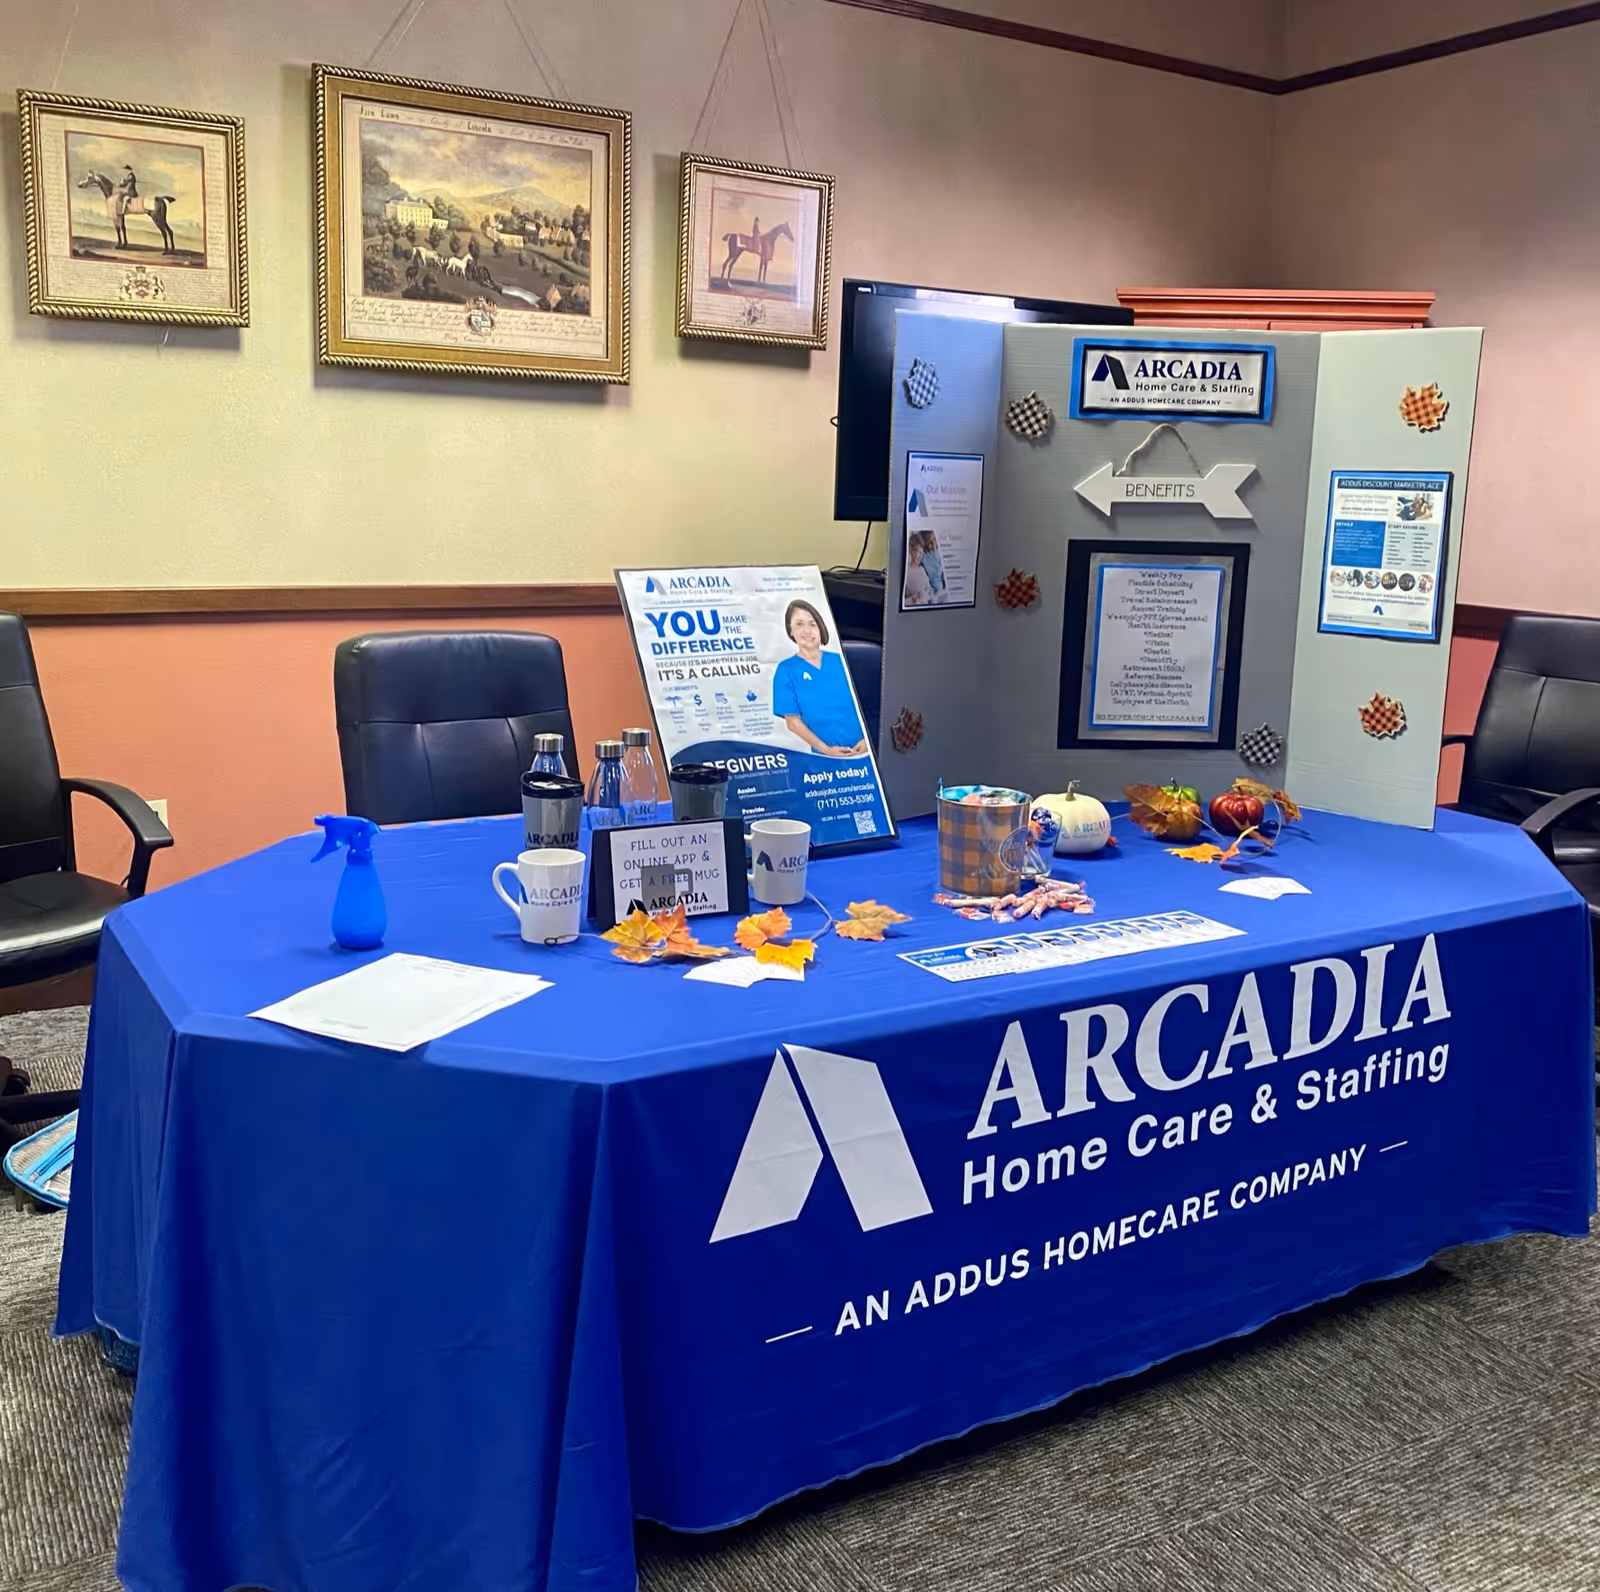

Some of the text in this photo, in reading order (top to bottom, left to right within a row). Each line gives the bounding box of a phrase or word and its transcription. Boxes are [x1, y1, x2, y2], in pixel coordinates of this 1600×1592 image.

[1134, 358, 1242, 381] ARCADIA
[1135, 382, 1255, 396] Home Care & Staffing
[1125, 483, 1195, 498] BENEFITS
[1393, 482, 1440, 490] MARKETPLACE
[669, 575, 731, 590] ARCADIA
[644, 609, 721, 638] YOU
[722, 615, 747, 624] MAKE
[724, 625, 743, 634] THE
[651, 637, 755, 656] DIFFERENCE
[688, 668, 698, 679] A
[701, 663, 761, 678] CALLING
[803, 766, 869, 784] Apply today!
[737, 786, 757, 795] Assist
[741, 806, 766, 816] Provide
[817, 798, 839, 811] (717)
[630, 833, 707, 851] FILL OUT AN
[623, 850, 710, 871] ONLINE APP &
[619, 868, 720, 890] GET A FREE MUG
[650, 891, 709, 910] ARCADIA
[967, 931, 1452, 1140] ARCADIA
[962, 1041, 1451, 1206] Home Care & Staffing
[834, 1142, 1368, 1337] AN ADDUS HOMECARE COMPANY
